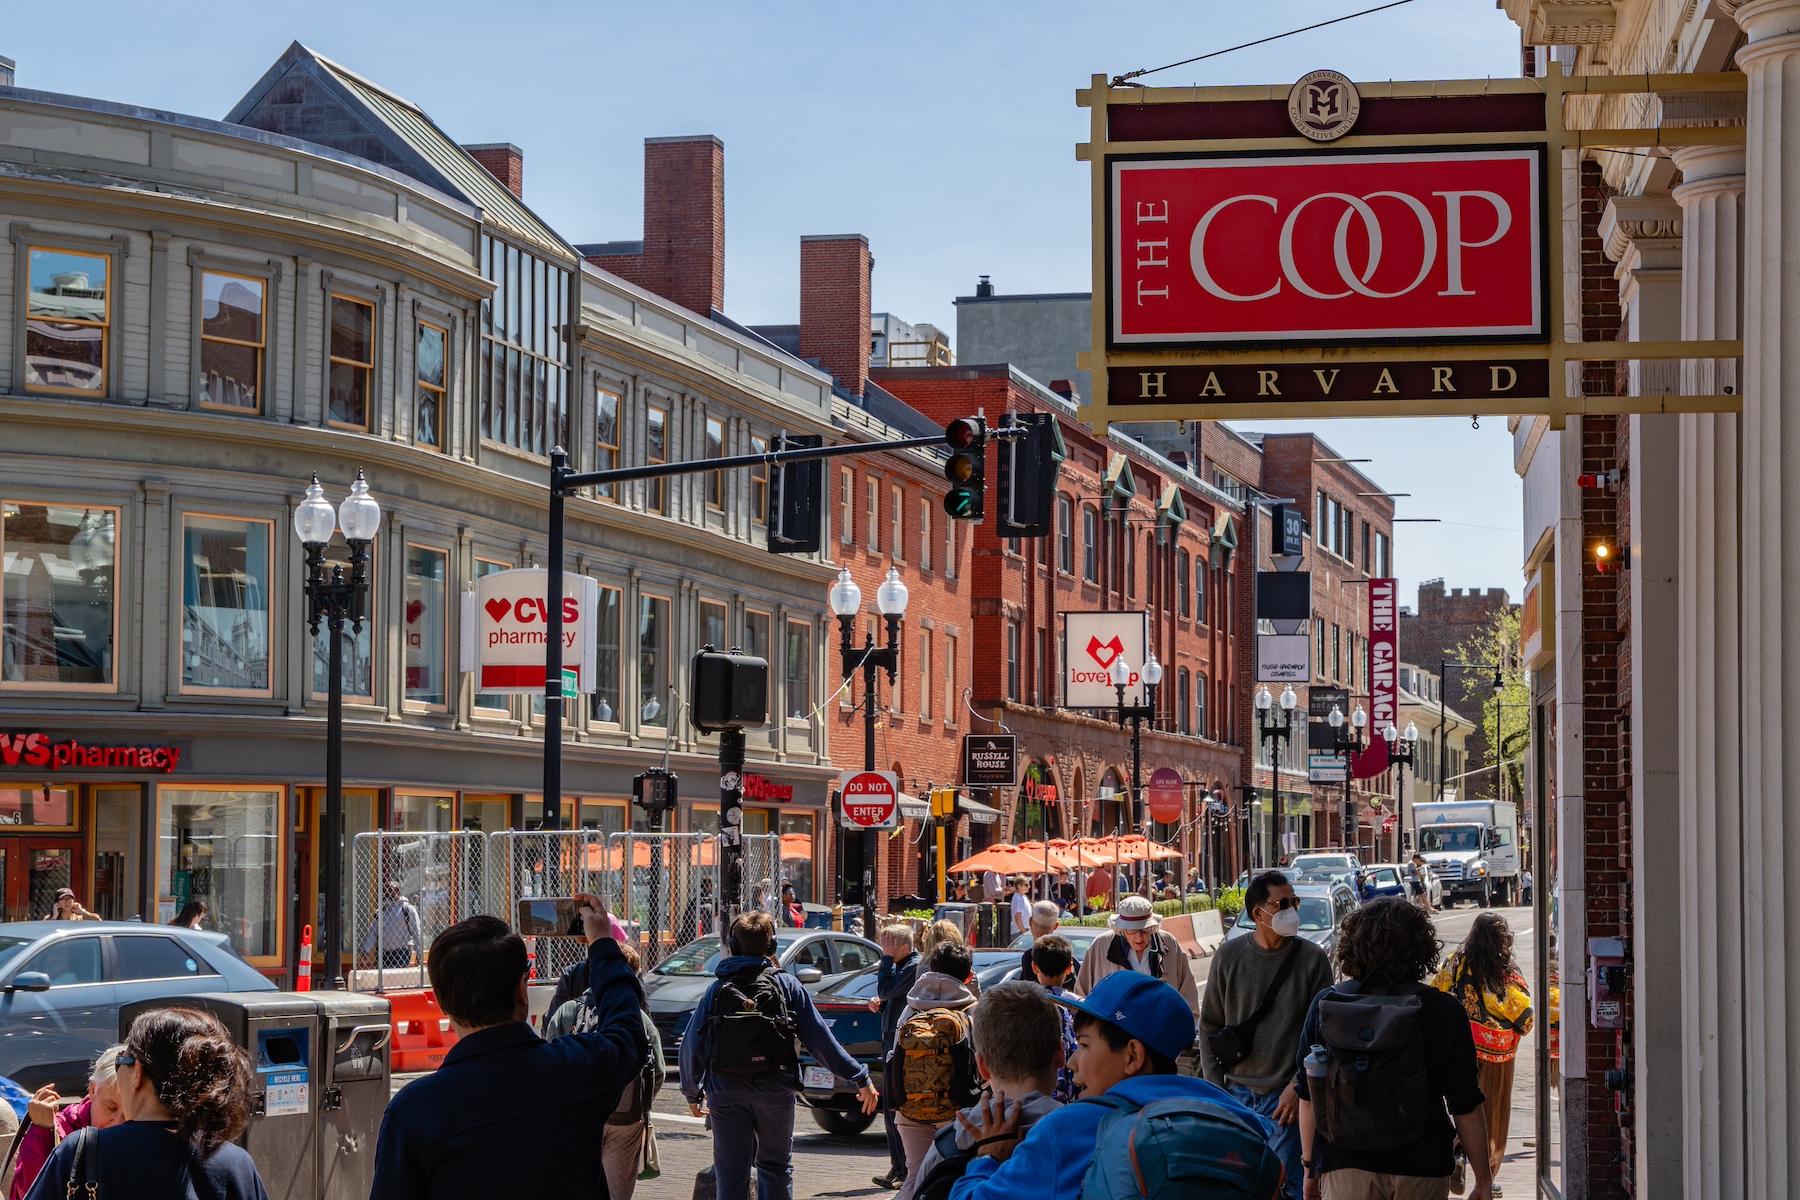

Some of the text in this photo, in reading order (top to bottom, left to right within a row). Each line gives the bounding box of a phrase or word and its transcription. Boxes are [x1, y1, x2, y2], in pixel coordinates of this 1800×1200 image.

[1305, 71, 1343, 82] HARVARD
[1290, 105, 1359, 139] COOPERATIVE SOCIETY
[1137, 200, 1169, 306] THE
[1189, 190, 1513, 302] COOP
[1138, 365, 1518, 398] HARVARD
[1286, 518, 1300, 536] 30
[1372, 582, 1393, 632] THE
[1071, 668, 1139, 687] lovep
[49, 739, 181, 773] pharmacy
[971, 752, 1010, 761] RUSSELL
[976, 760, 1006, 769] HOUSE
[850, 783, 887, 792] DO NOT
[853, 807, 884, 816] ENTER
